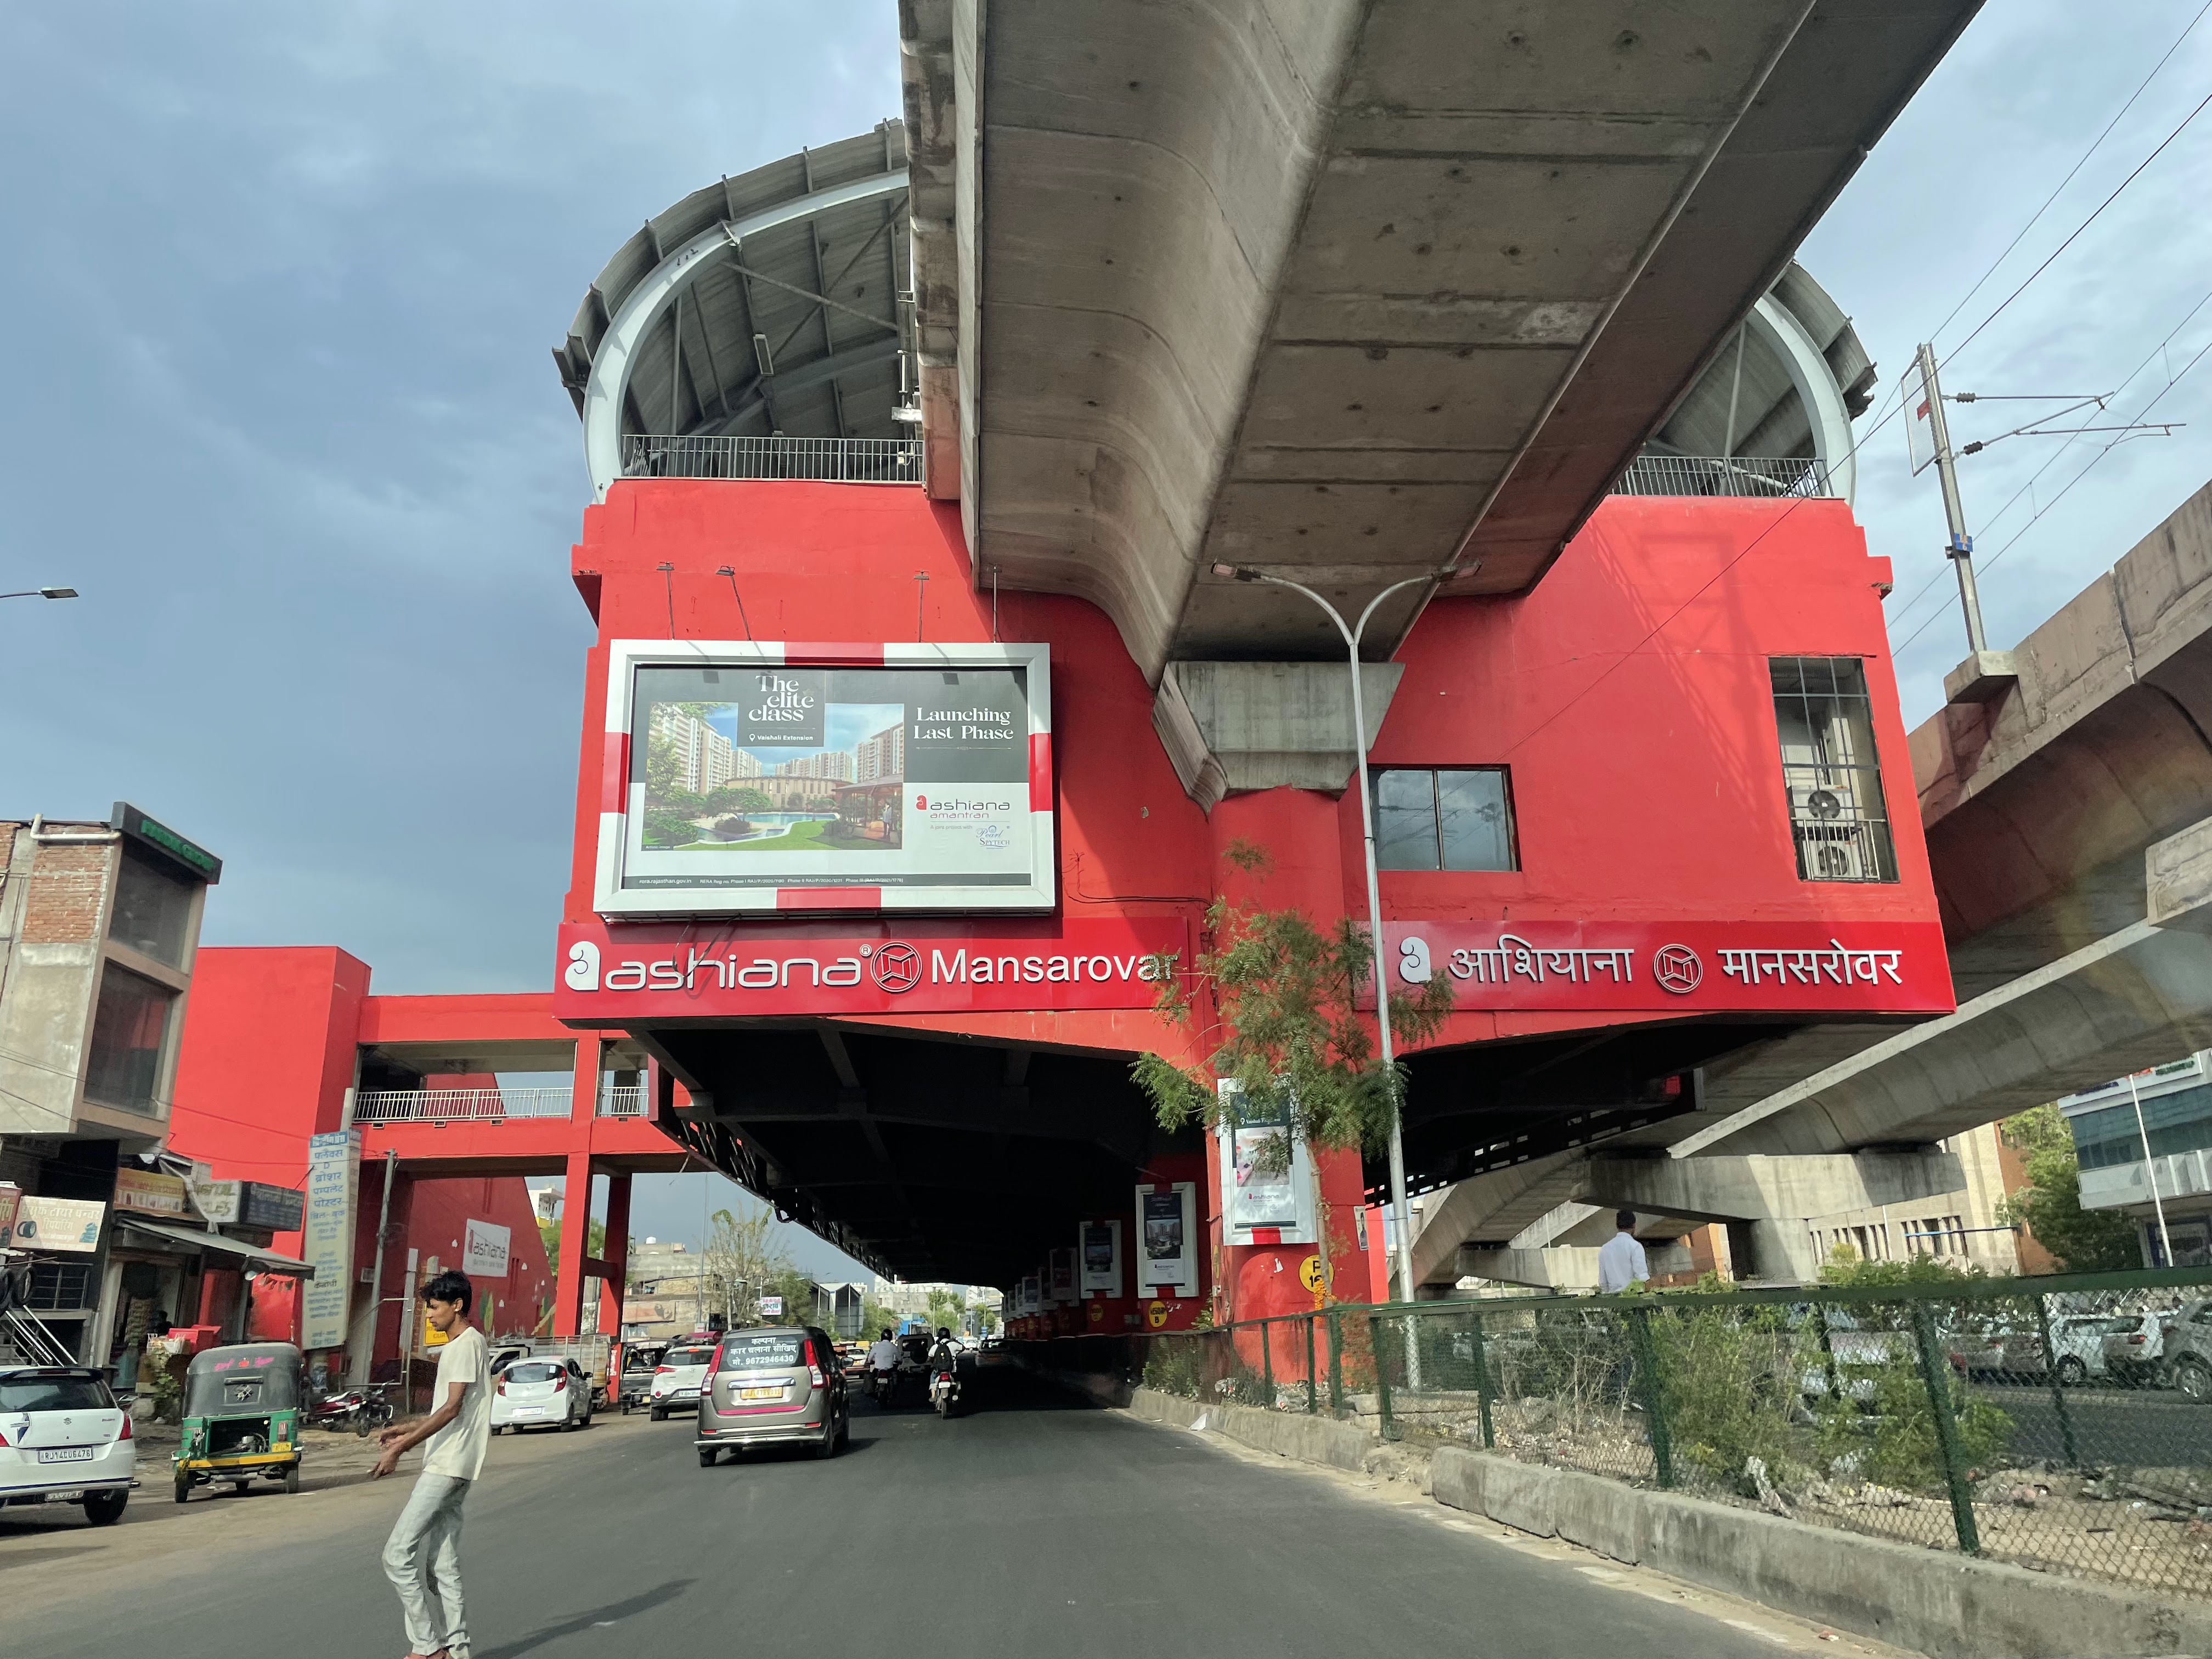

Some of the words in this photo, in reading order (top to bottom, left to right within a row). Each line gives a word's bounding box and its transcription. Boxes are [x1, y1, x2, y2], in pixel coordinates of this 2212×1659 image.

[755, 675, 799, 691] The
[767, 692, 814, 708] elite
[748, 704, 804, 721] class
[917, 707, 1011, 725] Launching
[914, 725, 953, 739] Last
[961, 725, 1014, 740] Phase
[930, 799, 1009, 810] ashiana
[976, 827, 1003, 838] Pearl
[932, 949, 1179, 983] Mansarovar
[1449, 934, 1634, 983] आशियाना
[1717, 938, 1903, 985] मानसरोवर
[606, 947, 861, 989] ashiana
[49, 1208, 74, 1218] टायर
[772, 1344, 797, 1353] सीखिए
[746, 1355, 794, 1365] 9672946430
